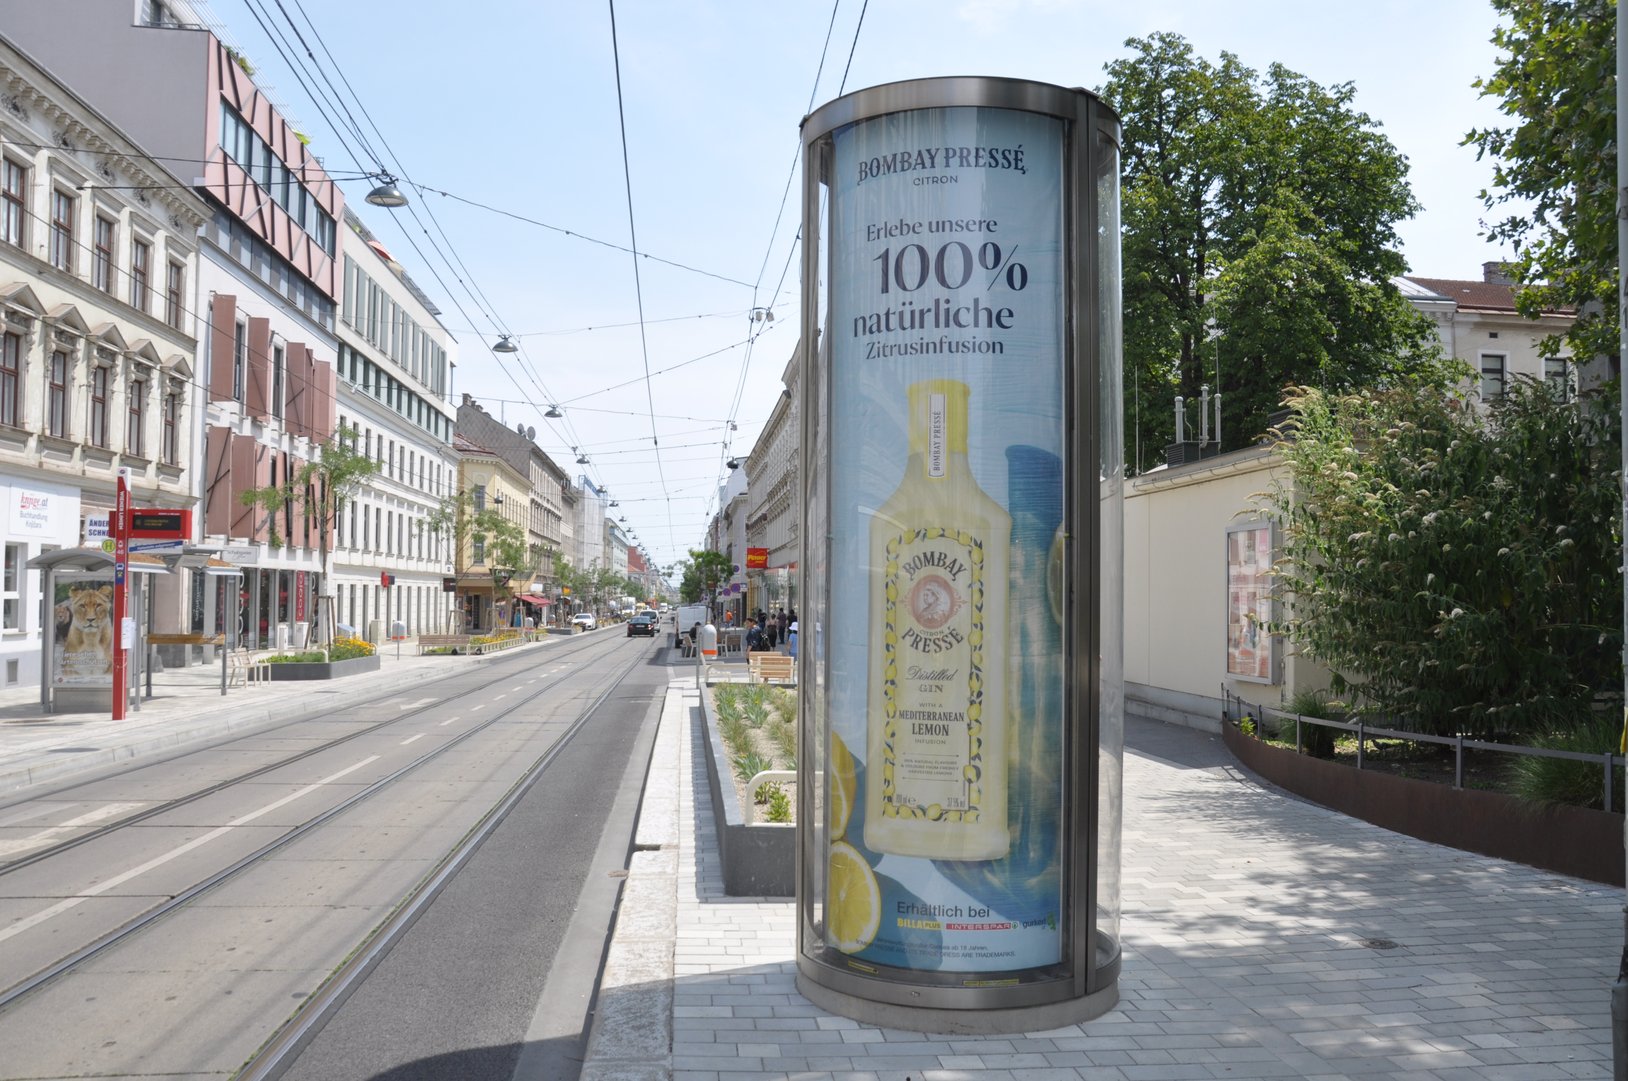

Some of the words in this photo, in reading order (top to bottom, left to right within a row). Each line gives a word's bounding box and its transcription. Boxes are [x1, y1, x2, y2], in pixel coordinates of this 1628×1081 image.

[857, 147, 940, 186] BOMBAY
[944, 144, 1026, 175] PRESSÉ
[913, 175, 958, 186] CITRON
[867, 219, 922, 242] Erlebe
[928, 219, 997, 233] unsere
[873, 241, 1028, 294] 100%
[854, 297, 1014, 337] natürliche
[866, 335, 1004, 359] Zitrusinfusion
[933, 441, 941, 471] BOMBAY
[902, 551, 968, 581] BOMBAY
[902, 626, 964, 654] PRESSÉ
[905, 665, 959, 681] Distilled
[919, 684, 943, 693] GIN
[899, 710, 965, 722] MEDITERRANEAN
[912, 723, 949, 736] LEMON
[897, 902, 963, 918] Erhältlich
[968, 906, 990, 918] bei
[897, 918, 925, 928] BILLA
